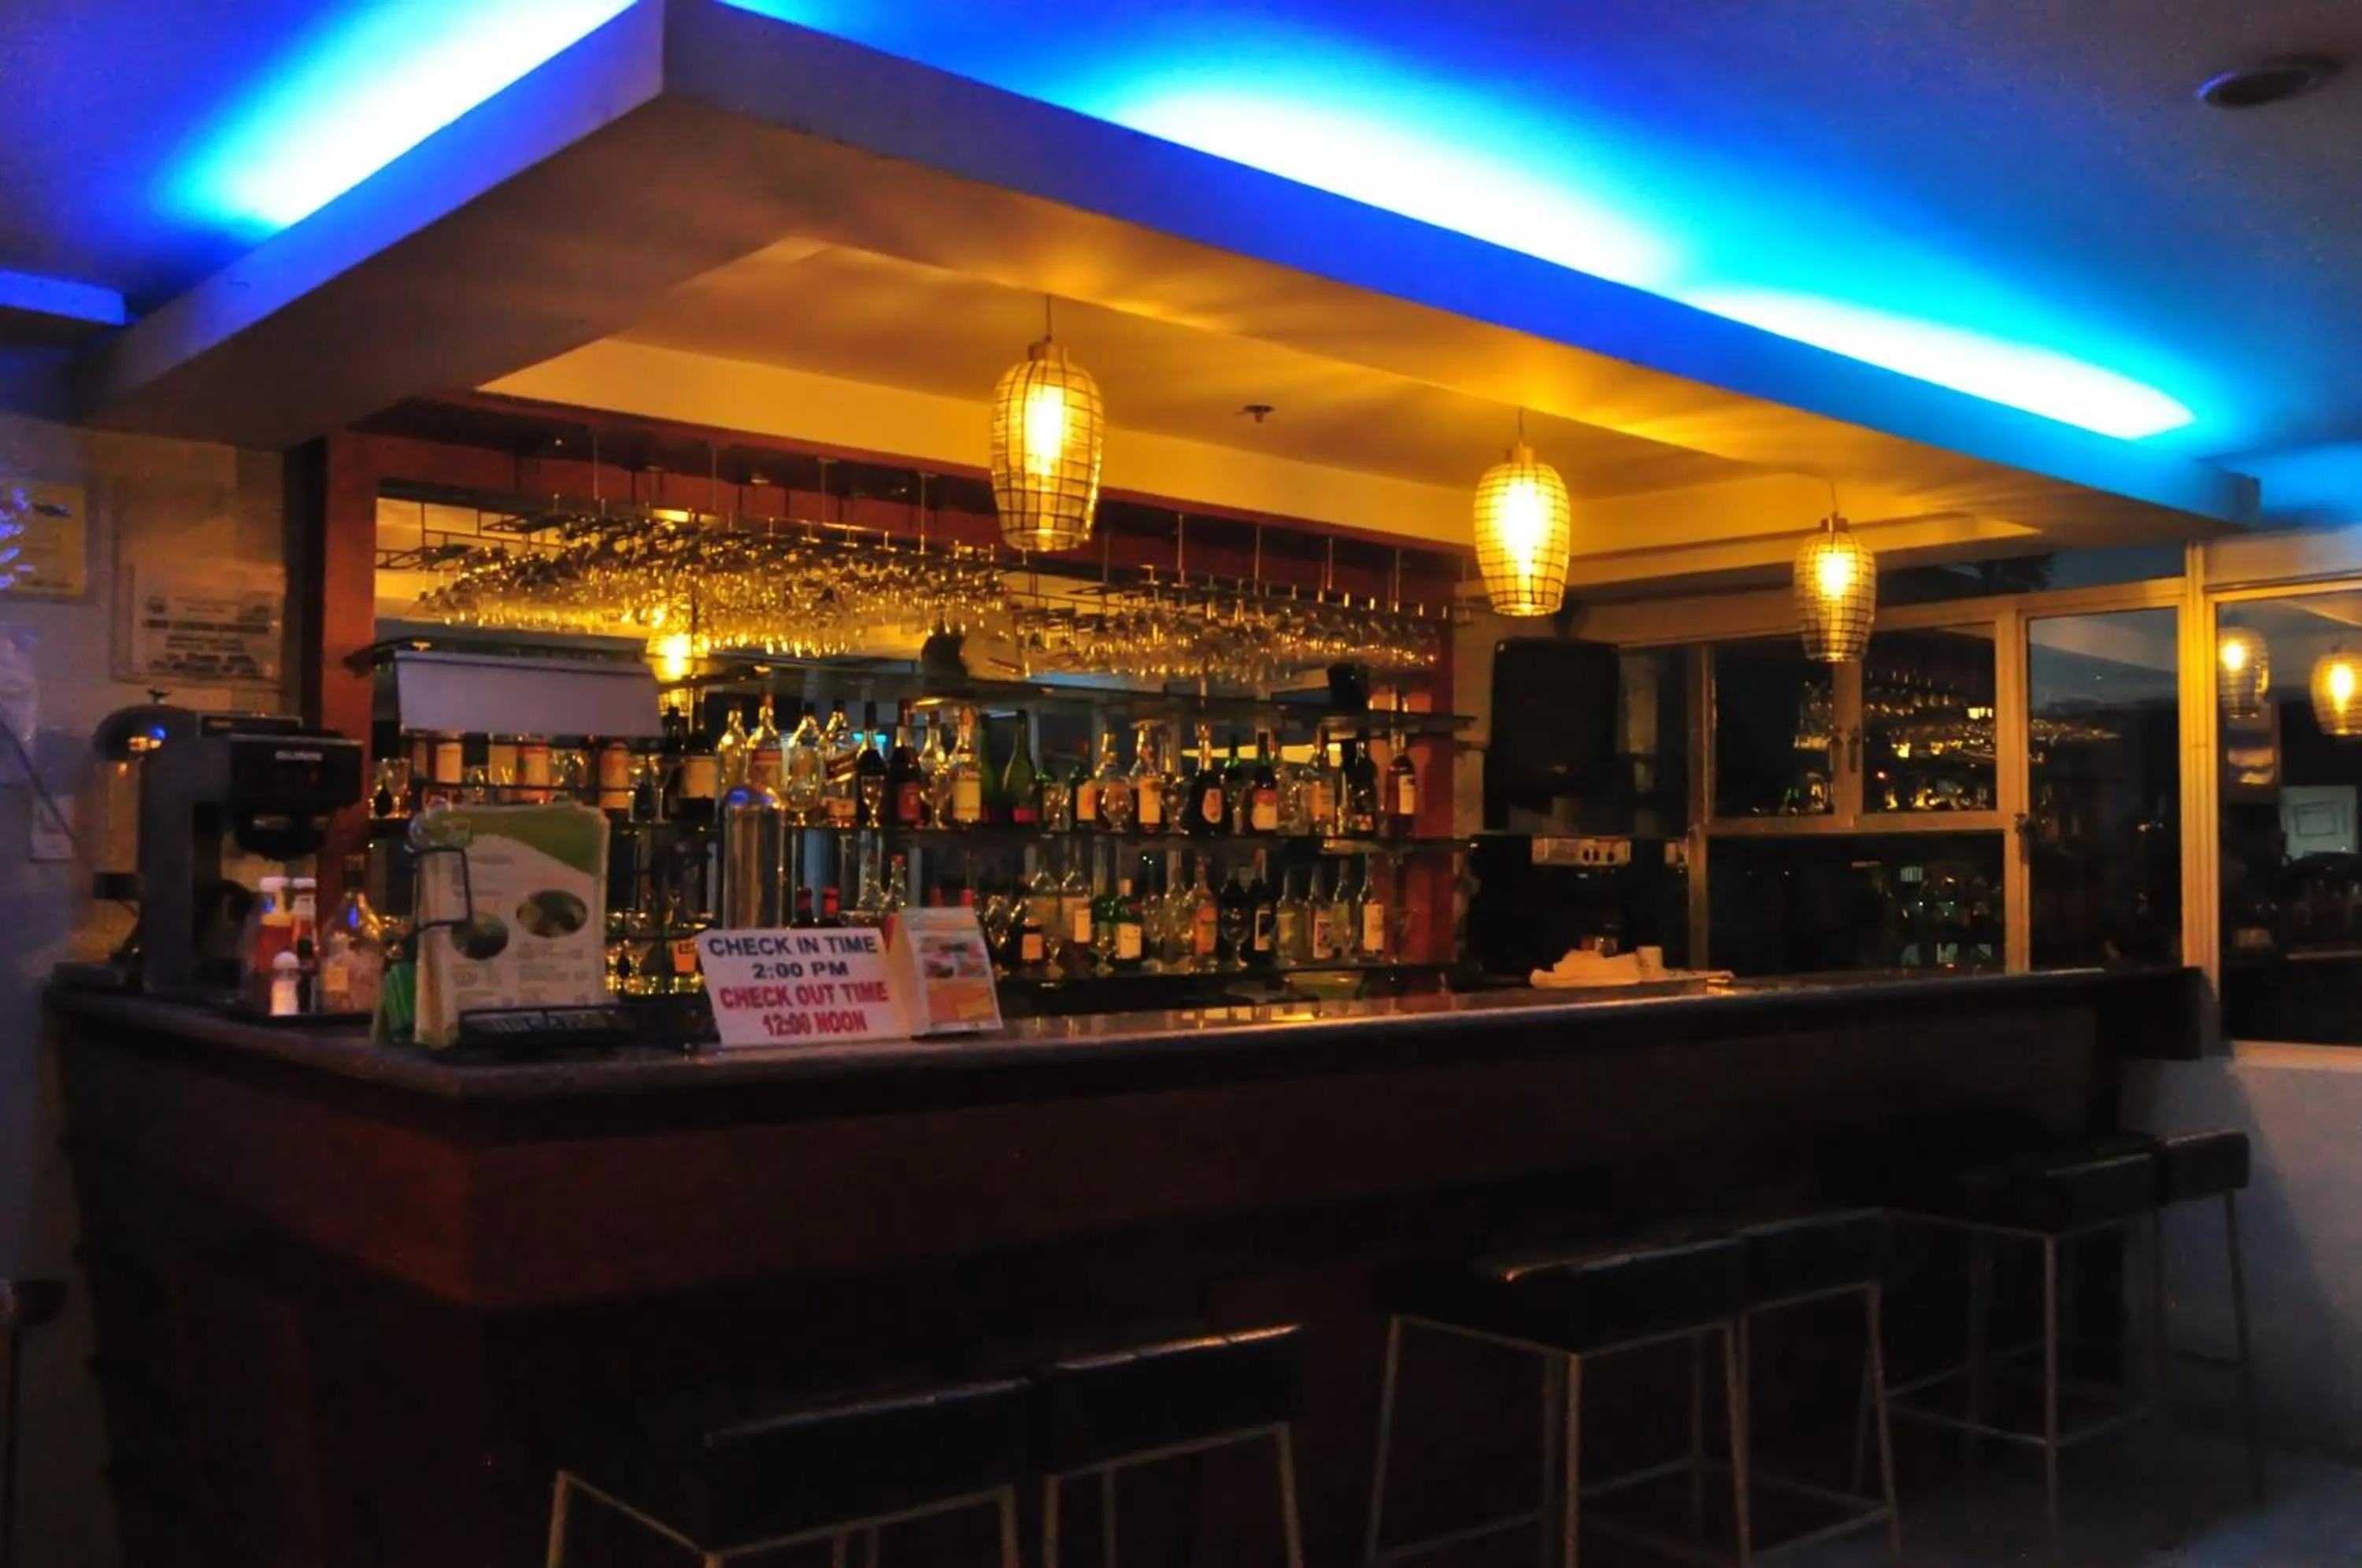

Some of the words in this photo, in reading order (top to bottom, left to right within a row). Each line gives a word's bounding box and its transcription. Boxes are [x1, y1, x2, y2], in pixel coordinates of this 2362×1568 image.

[709, 937, 791, 956] CHECK
[798, 936, 820, 955] IN
[824, 935, 878, 954] TIME
[752, 962, 803, 979] 2:00
[811, 961, 849, 978] PM
[720, 986, 793, 1008] CHECK
[796, 984, 835, 1006] OUT
[840, 982, 889, 1003] TIME
[763, 1012, 812, 1036] 12:00
[813, 1010, 868, 1034] NOON
